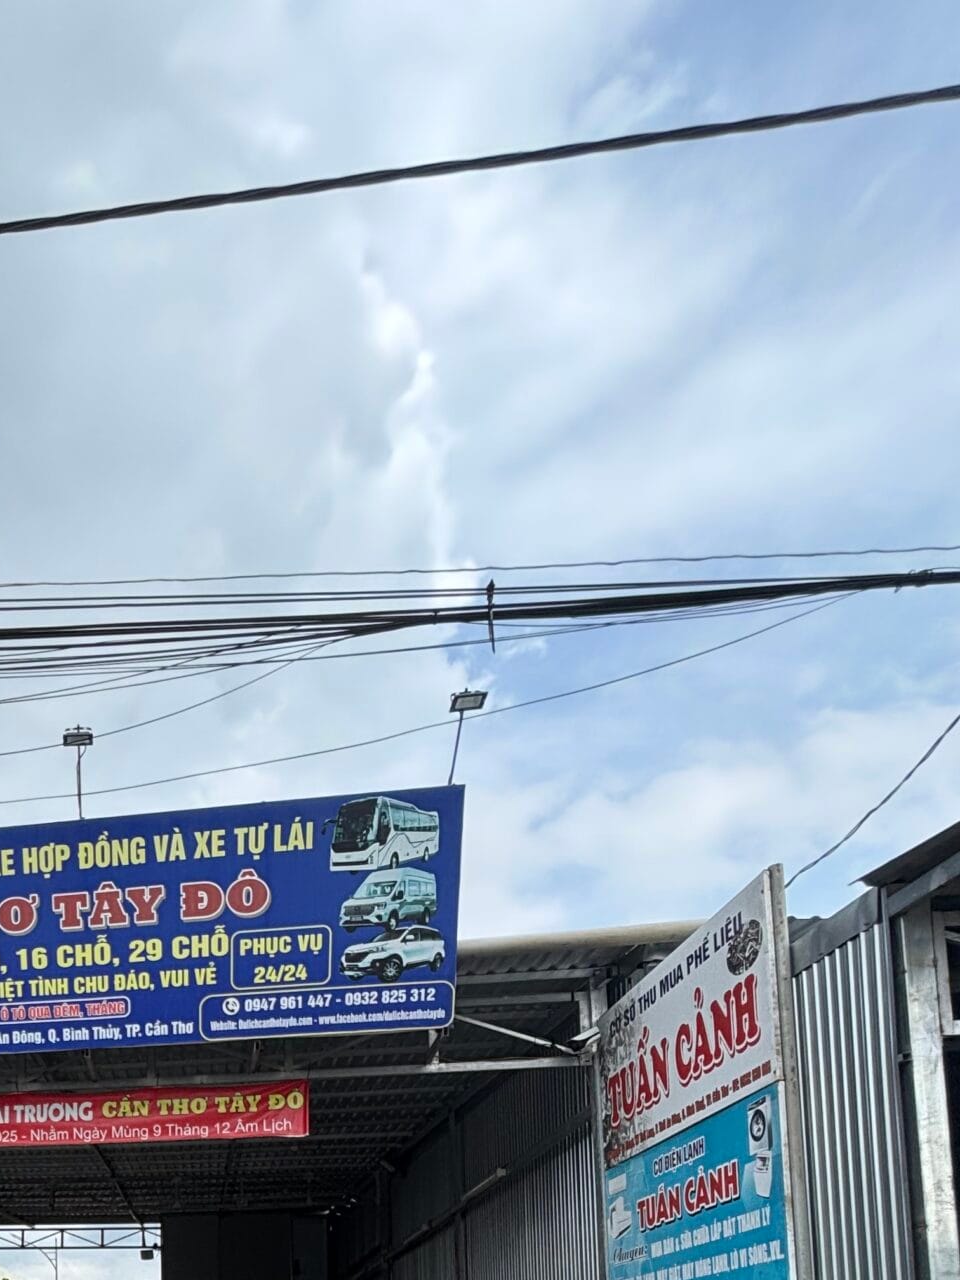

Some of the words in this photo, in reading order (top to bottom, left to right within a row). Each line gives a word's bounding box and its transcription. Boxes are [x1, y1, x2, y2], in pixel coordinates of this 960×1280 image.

[22, 842, 70, 878] HỢP
[78, 832, 146, 869] ĐỒNG
[154, 827, 186, 863] VÀ
[194, 830, 225, 859] XE
[234, 824, 268, 860] TỰ
[274, 817, 313, 852] LÁI
[52, 881, 164, 931] TÂY
[180, 868, 271, 920] ĐÔ
[16, 947, 48, 970] 16
[56, 934, 120, 967] CHỖ,
[128, 938, 163, 963] 29
[172, 924, 229, 959] CHỖ
[240, 936, 292, 958] PHỤC
[298, 933, 323, 954] VỤ
[29, 975, 69, 997] TÌNH
[74, 974, 108, 994] CHU
[114, 969, 154, 991] ĐÁO,
[160, 969, 189, 988] VUI
[194, 962, 217, 985] VẺ
[254, 964, 308, 984] 24/24
[638, 985, 656, 1014] THU
[659, 966, 684, 999] MUA
[686, 931, 710, 976] PHẾ
[28, 1005, 52, 1020] QUA
[244, 998, 276, 1012] 0947
[279, 996, 302, 1009] 961
[307, 994, 332, 1008] 447
[344, 991, 378, 1006] 0932
[381, 989, 407, 1003] 825
[410, 988, 436, 1001] 312
[12, 1030, 45, 1045] Đông,
[48, 1028, 60, 1042] Q.
[62, 1026, 89, 1041] Bình
[125, 1025, 141, 1037] TP.
[145, 1020, 168, 1036] Cần
[171, 1021, 194, 1034] Thơ
[607, 1026, 670, 1130] TUẤN
[675, 973, 761, 1087] CẢNH
[102, 1095, 149, 1118] CẦN
[157, 1096, 207, 1115] THƠ
[215, 1092, 261, 1113] TÂY
[268, 1088, 304, 1110] ĐÔ
[73, 1127, 107, 1142] Ngày
[111, 1124, 149, 1140] Mùng
[153, 1124, 162, 1137] 9
[166, 1122, 209, 1138] Tháng
[214, 1122, 230, 1134] 12
[234, 1118, 258, 1133] Âm
[263, 1118, 292, 1134] Lịch
[637, 1182, 682, 1232] TUẤN
[684, 1158, 740, 1216] CẢNH
